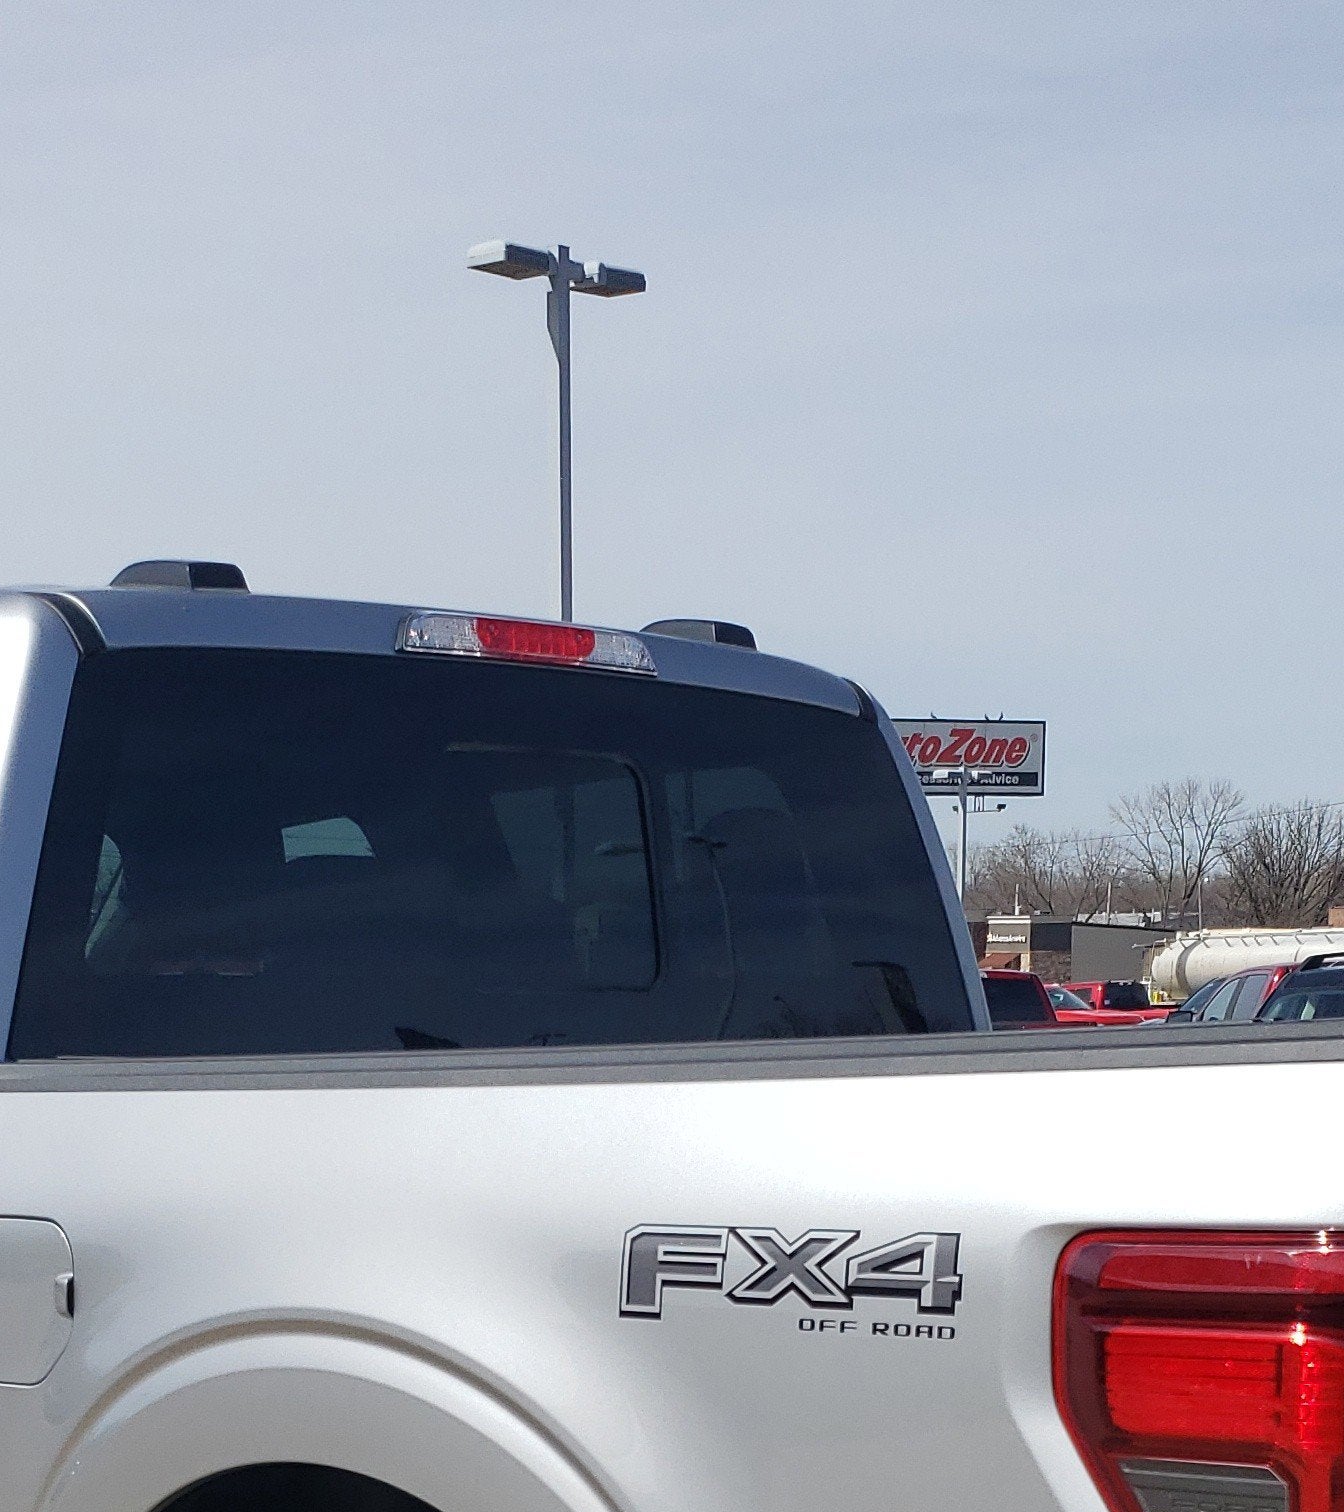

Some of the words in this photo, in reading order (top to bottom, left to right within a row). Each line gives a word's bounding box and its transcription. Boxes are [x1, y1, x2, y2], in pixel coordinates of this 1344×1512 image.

[901, 728, 1030, 766] toZone
[619, 1223, 963, 1320] FX4
[798, 1317, 858, 1333] OFF
[871, 1321, 956, 1340] ROAD
